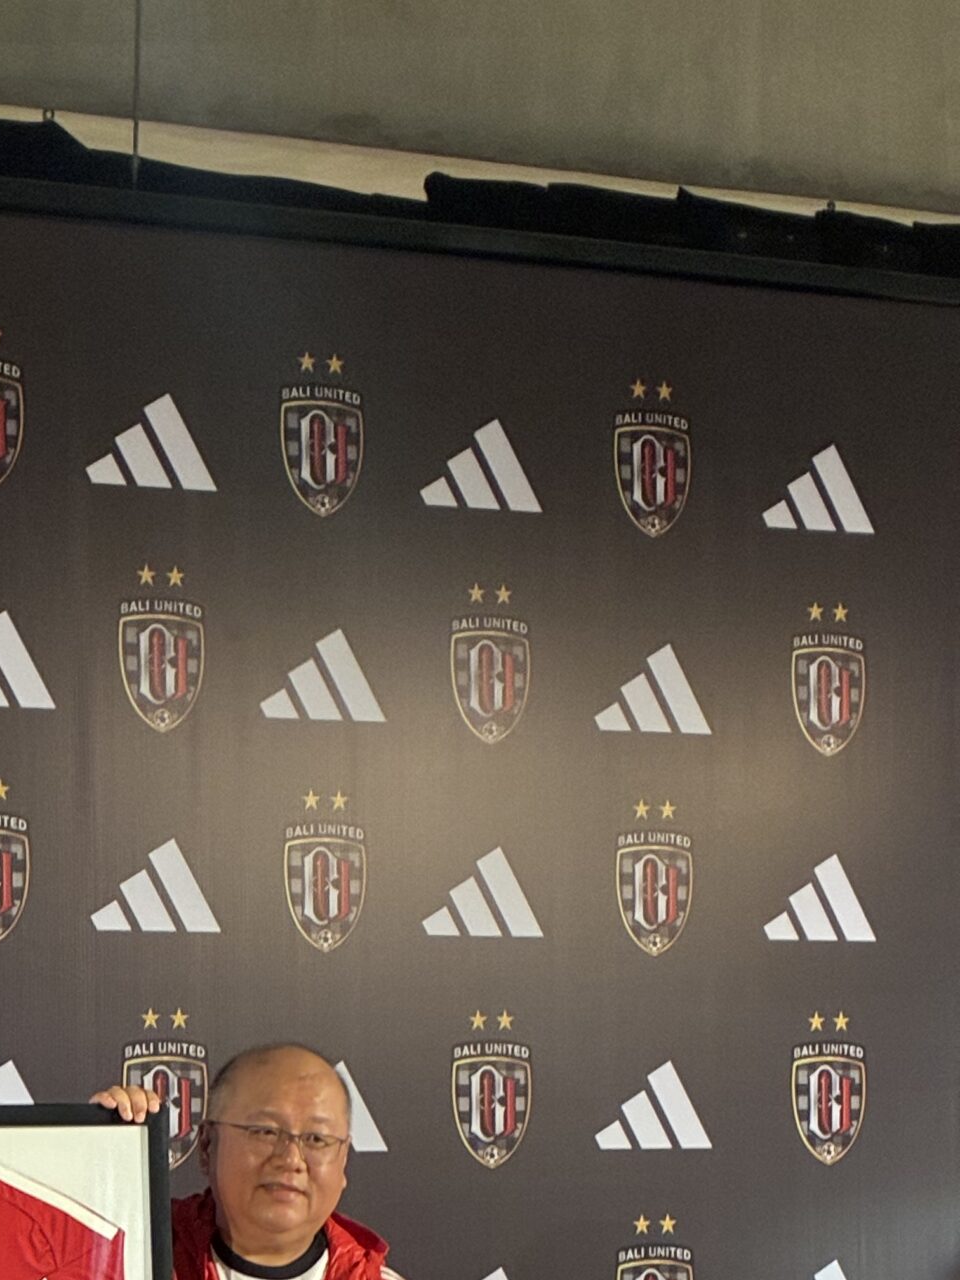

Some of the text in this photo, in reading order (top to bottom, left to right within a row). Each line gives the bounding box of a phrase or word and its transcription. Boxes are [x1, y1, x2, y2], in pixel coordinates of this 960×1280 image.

[281, 386, 360, 405] BALI UNITED
[615, 412, 688, 430] BALI UNITED
[120, 600, 202, 618] BALI UNITED
[451, 617, 528, 634] BALI UNITED
[792, 634, 864, 651] BALI UNITED
[286, 824, 365, 840] BALI UNITED
[618, 832, 691, 849] BALI UNITED
[124, 1042, 206, 1058] BALI UNITED
[454, 1043, 529, 1059] BALI UNITED
[793, 1043, 864, 1059] BALI UNITED
[619, 1246, 691, 1263] BALI UNITED
